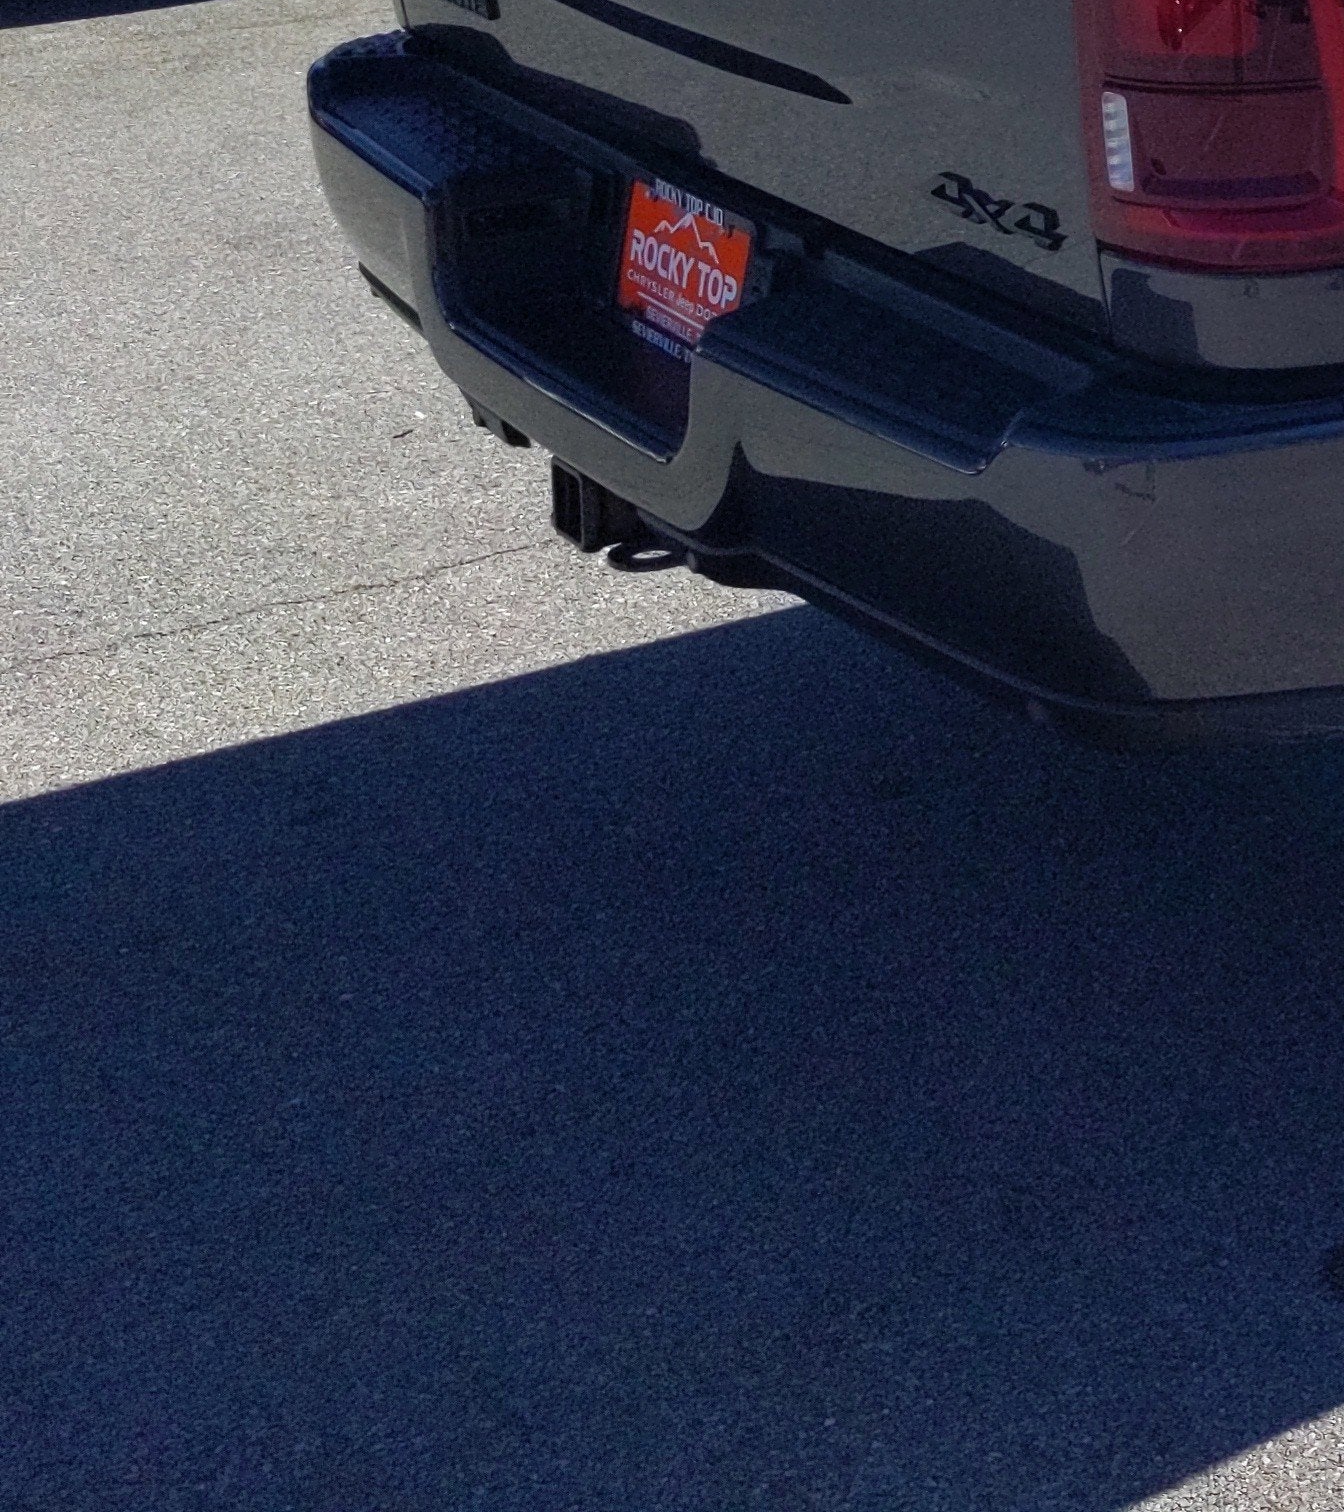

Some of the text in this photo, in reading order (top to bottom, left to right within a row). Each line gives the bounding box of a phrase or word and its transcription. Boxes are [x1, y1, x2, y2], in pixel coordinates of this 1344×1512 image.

[655, 177, 683, 208] ROCKY
[685, 190, 704, 215] TOP
[627, 268, 675, 302] CHRYSLER
[630, 228, 738, 309] ROCKY TOP
